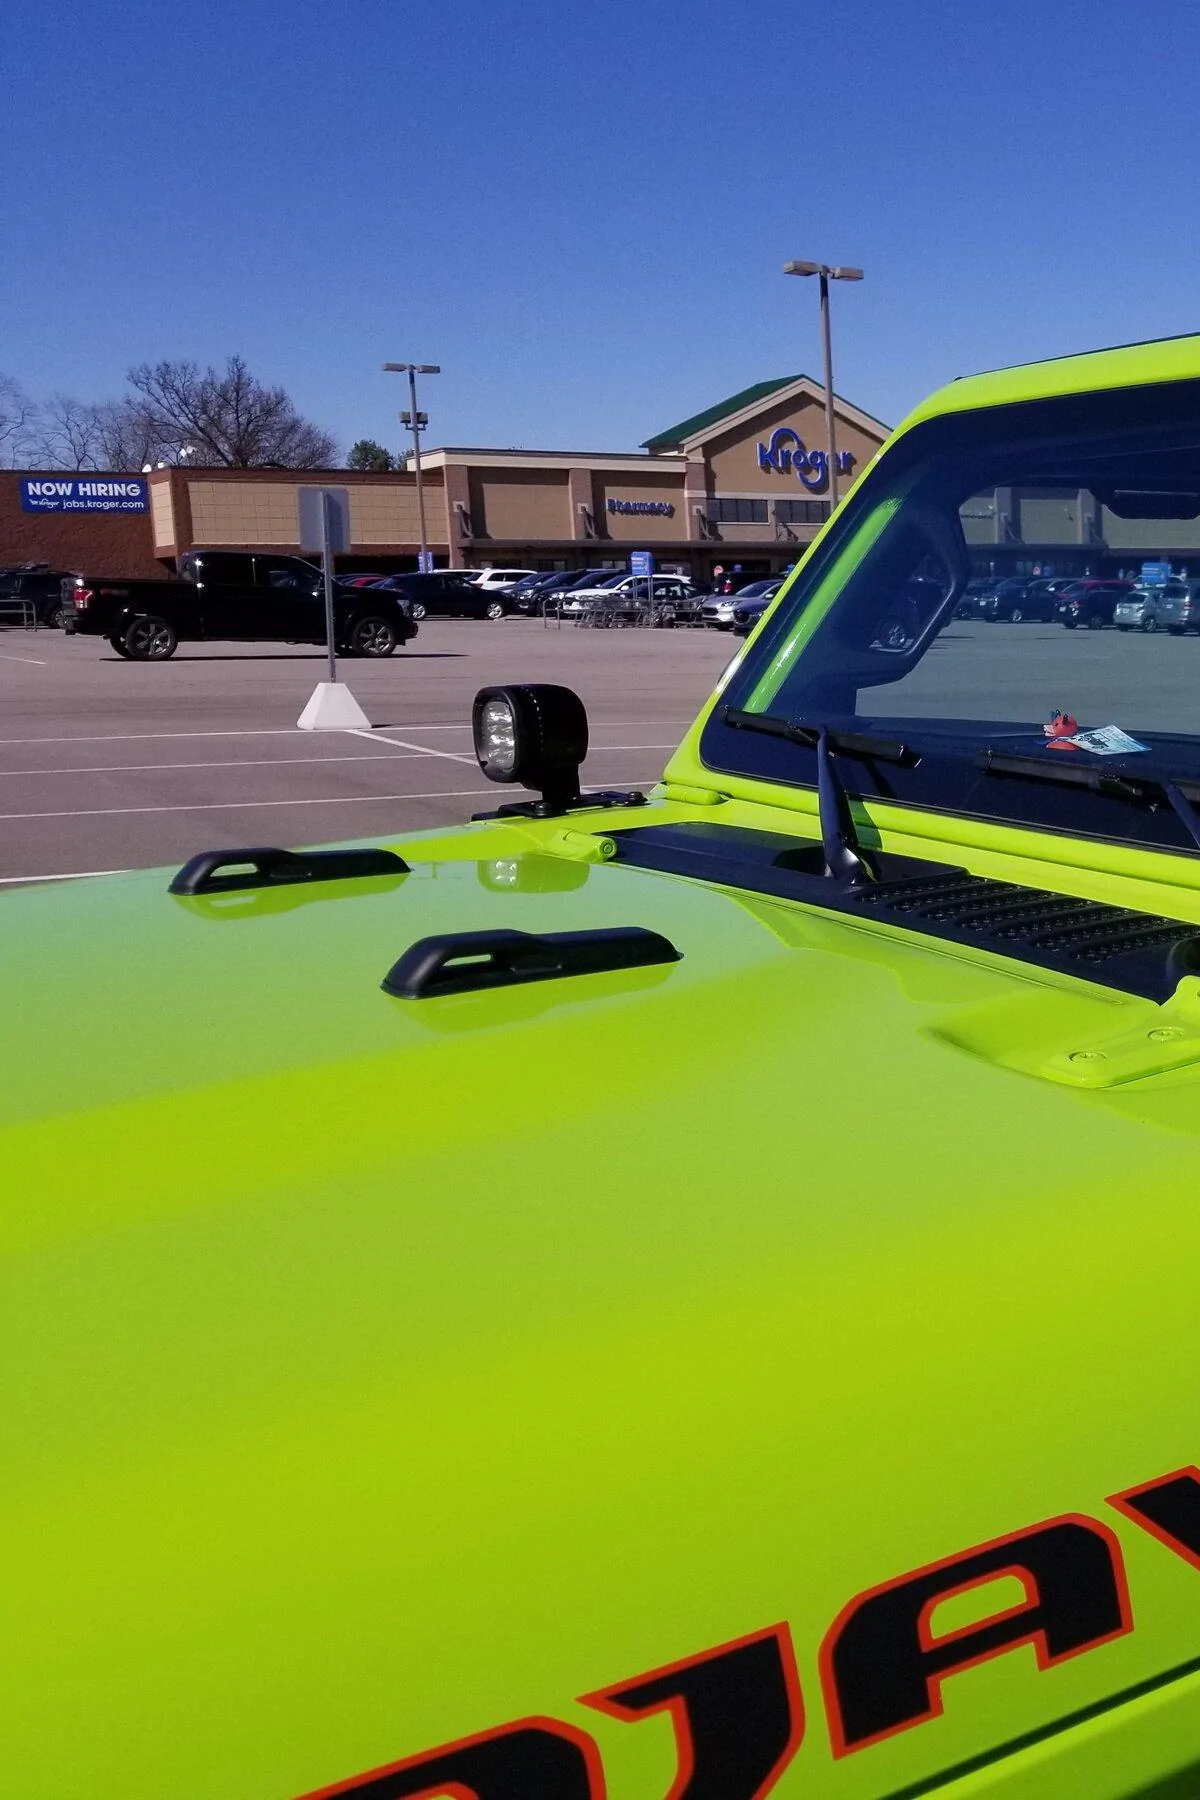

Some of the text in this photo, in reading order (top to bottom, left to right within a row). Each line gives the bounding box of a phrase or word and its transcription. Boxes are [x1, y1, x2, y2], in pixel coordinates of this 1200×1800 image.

[27, 482, 141, 497] NOW HIRING
[62, 499, 145, 510] jobs.kroger.com
[605, 498, 670, 514] Pharmacy
